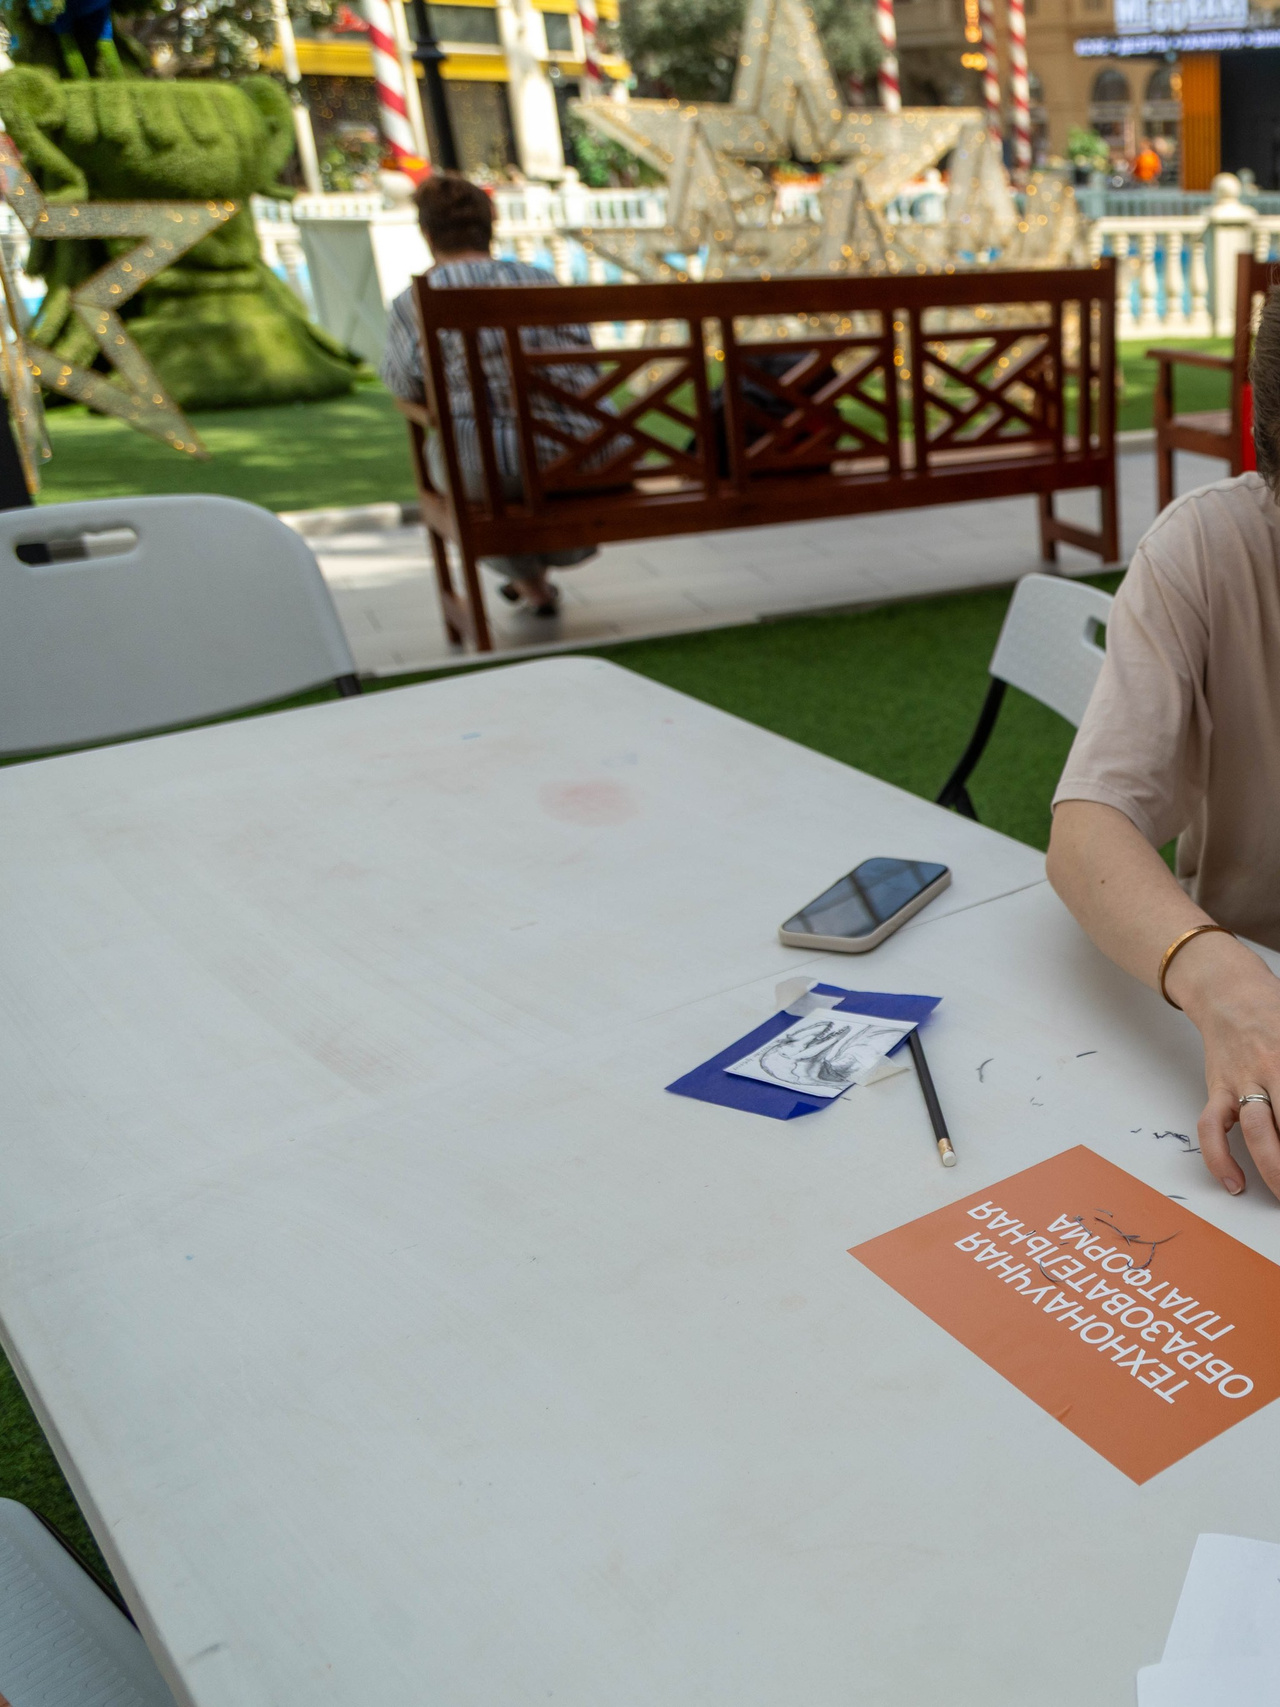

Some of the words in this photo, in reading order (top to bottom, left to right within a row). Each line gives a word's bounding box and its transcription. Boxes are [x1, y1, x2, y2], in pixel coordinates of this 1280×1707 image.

[954, 1230, 1189, 1404] ТЕХНОНАУЧНАЯ
[966, 1200, 1254, 1400] ОБРАЗОВАТЕЛЬНАЯ
[1045, 1212, 1235, 1342] ПЛАТФОРМА
